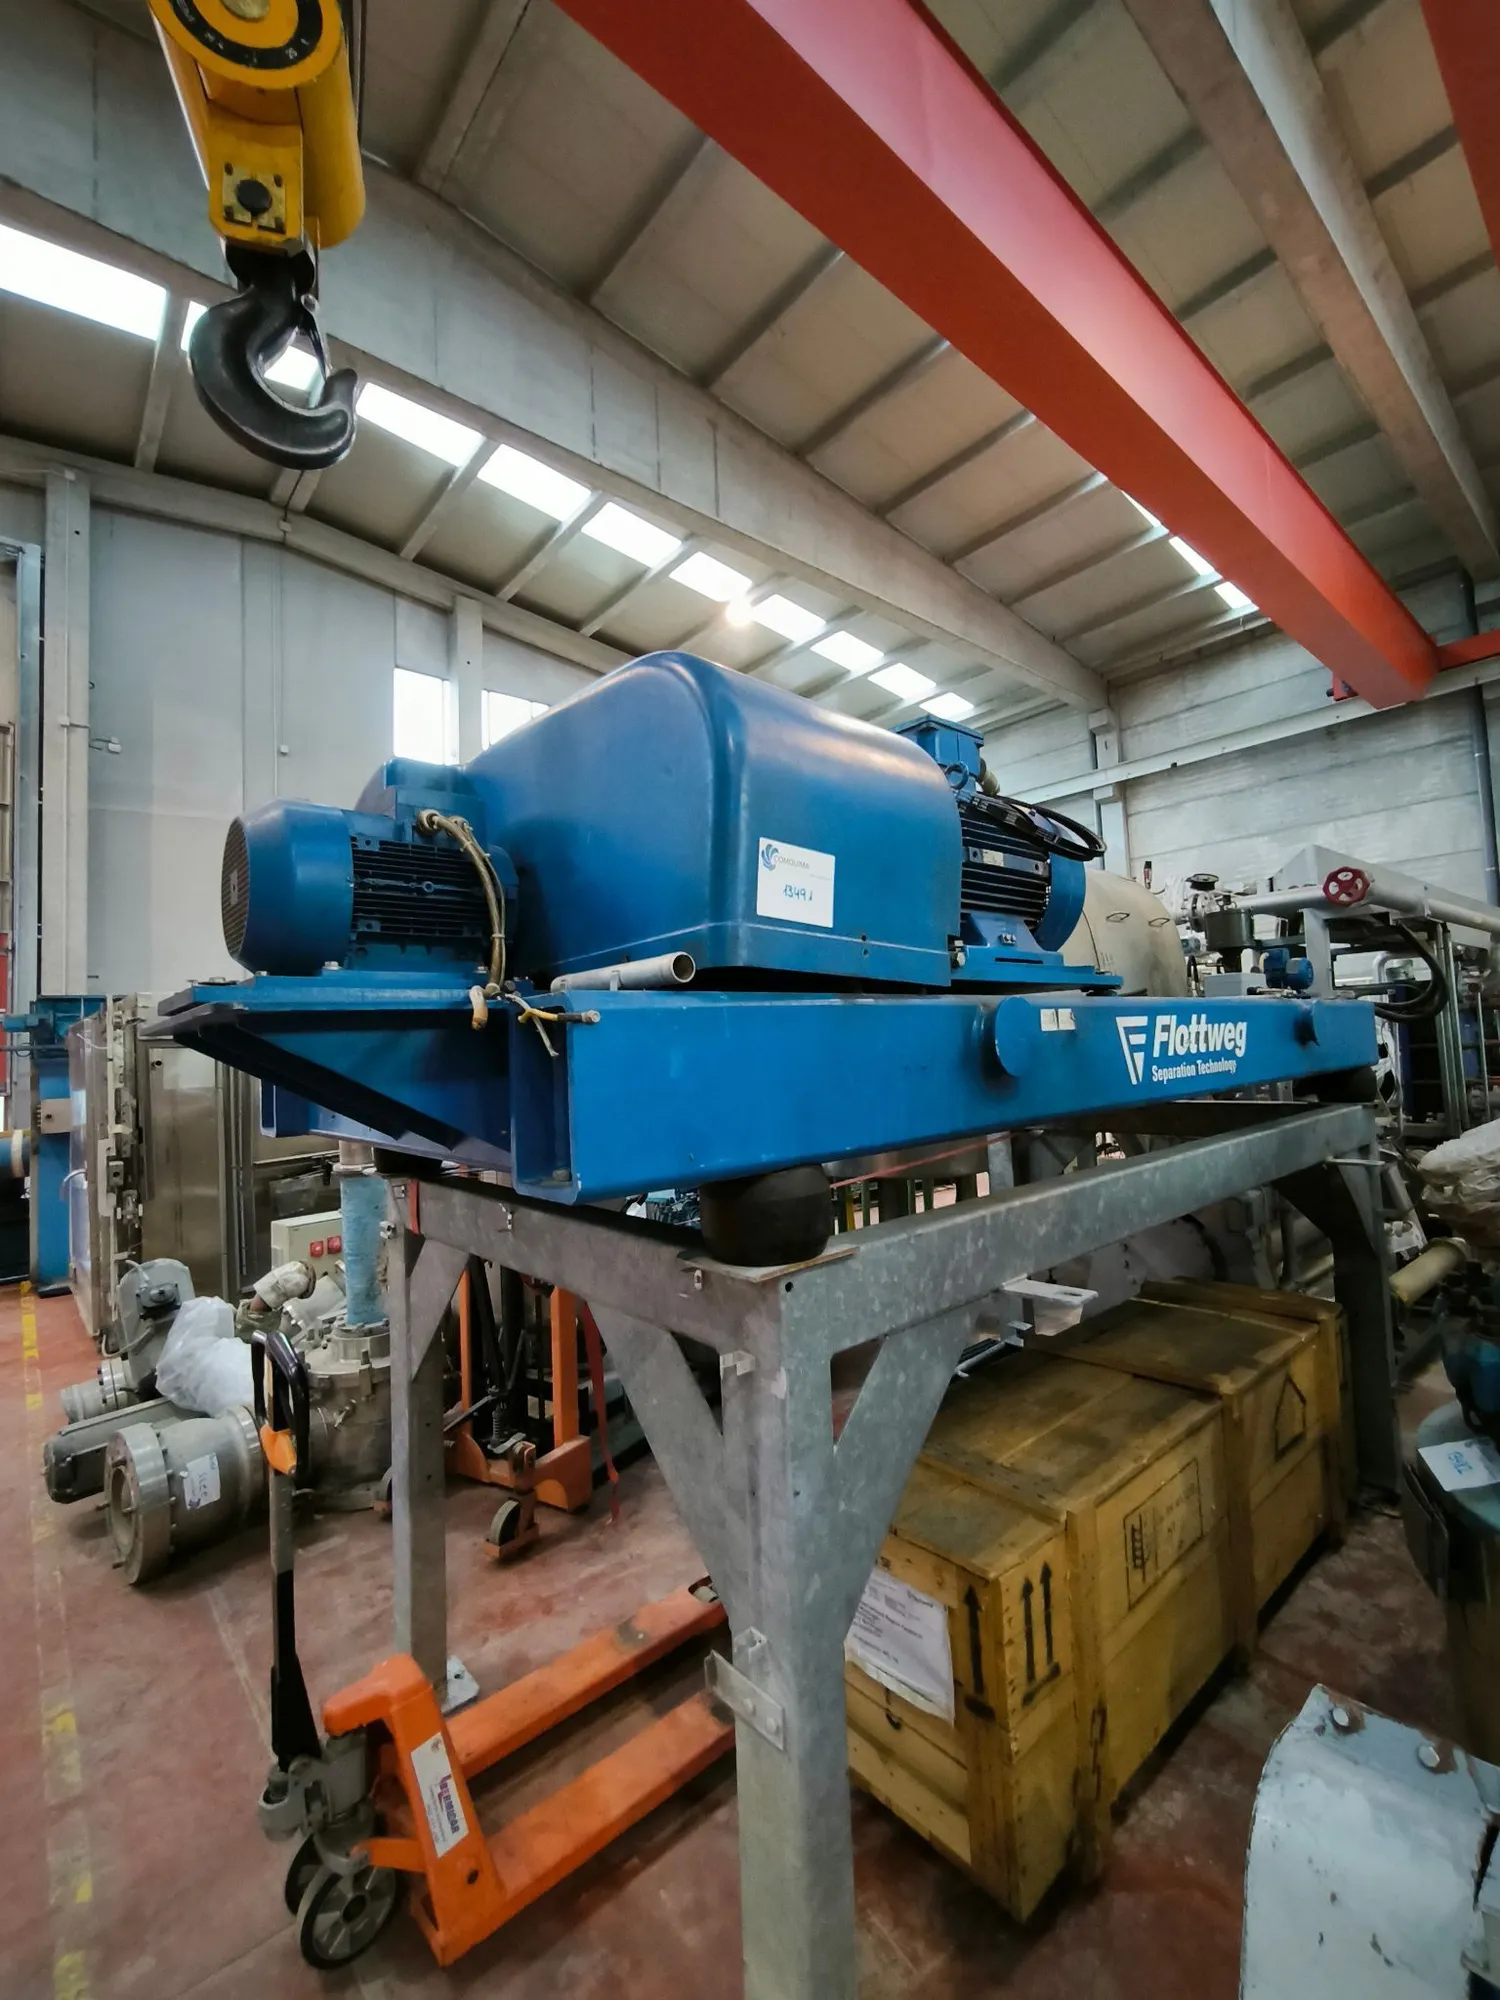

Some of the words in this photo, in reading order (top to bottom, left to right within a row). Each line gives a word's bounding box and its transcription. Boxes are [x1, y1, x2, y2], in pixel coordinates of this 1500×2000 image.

[1153, 1014, 1247, 1057] Flottweg
[1152, 1062, 1195, 1084] Separation
[1197, 1057, 1236, 1074] Technology
